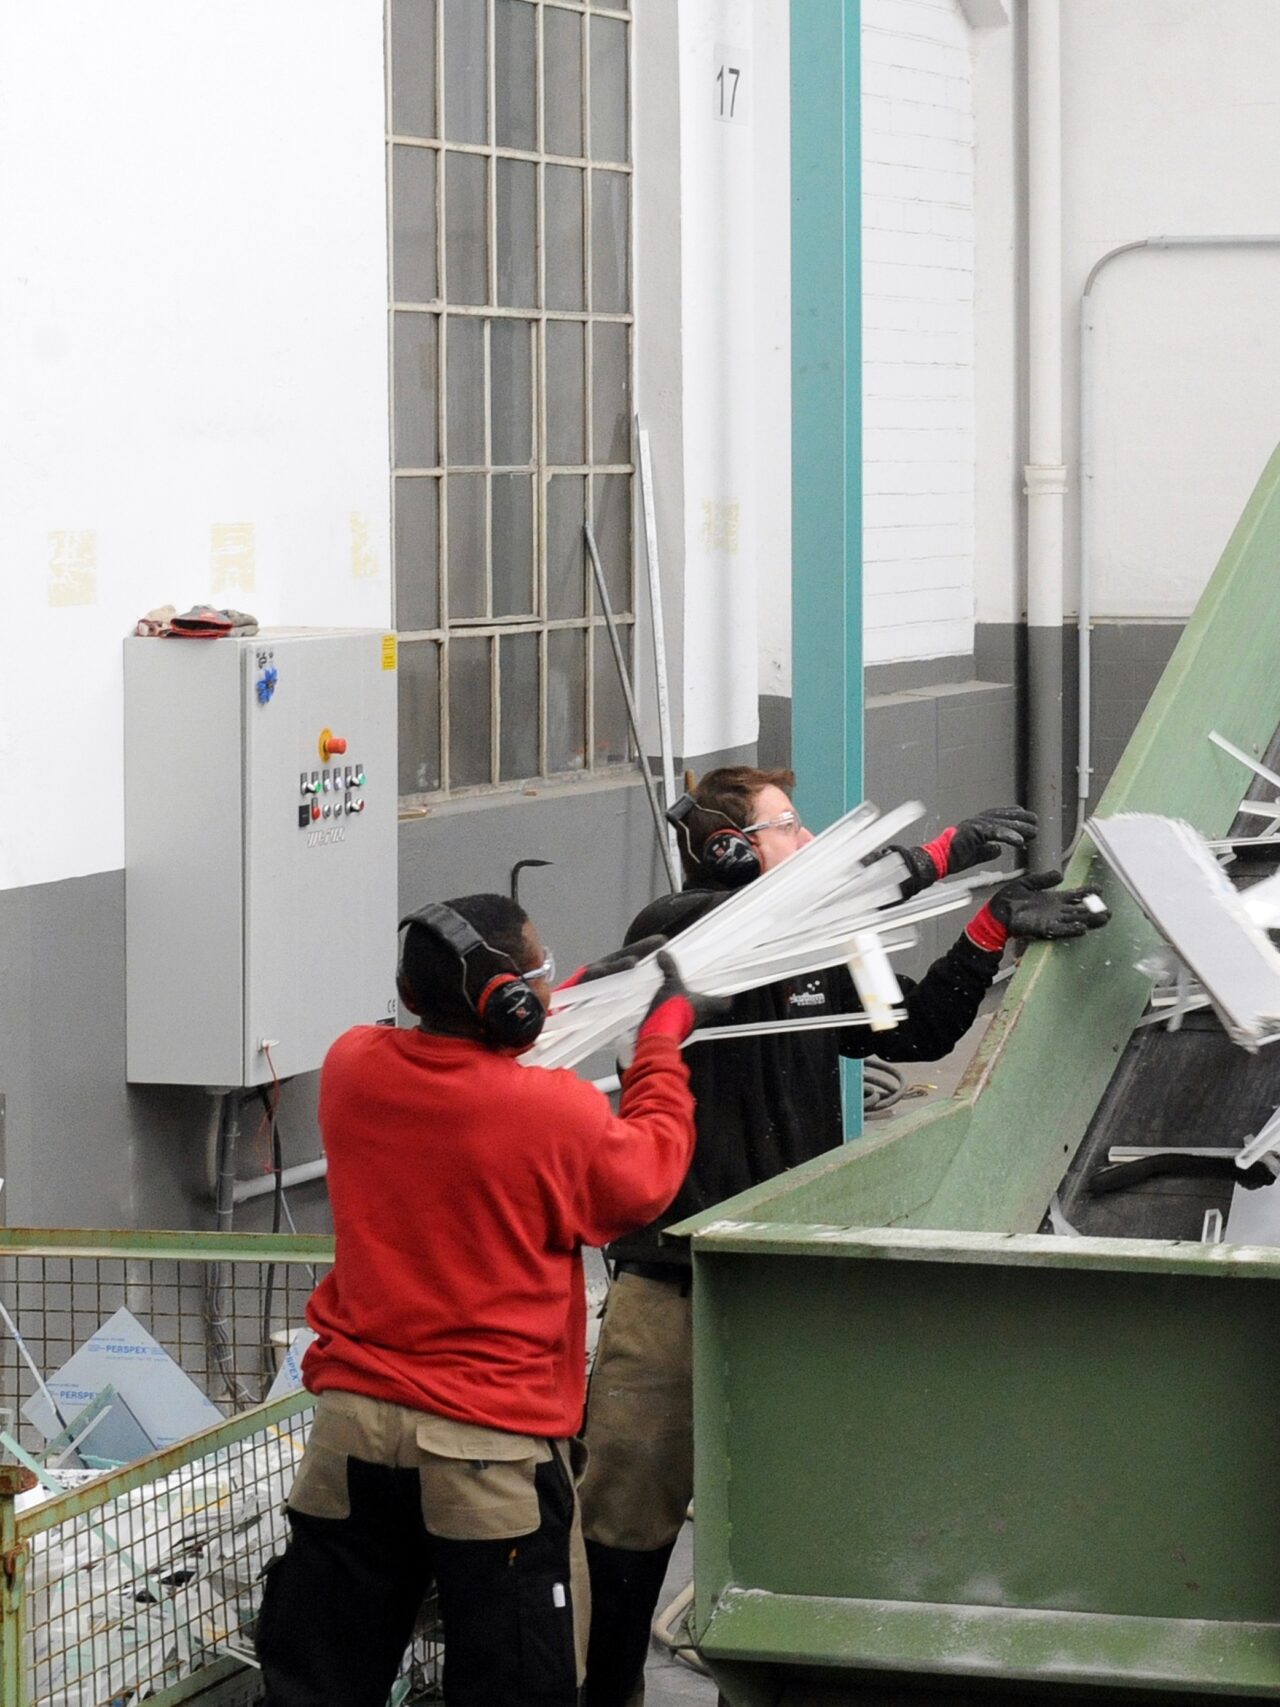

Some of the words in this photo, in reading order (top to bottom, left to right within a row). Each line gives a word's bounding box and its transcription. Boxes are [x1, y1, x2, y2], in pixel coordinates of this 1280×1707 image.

[716, 64, 740, 118] 17
[105, 1344, 147, 1354] PERSPEX
[60, 1390, 97, 1399] PERSPE
